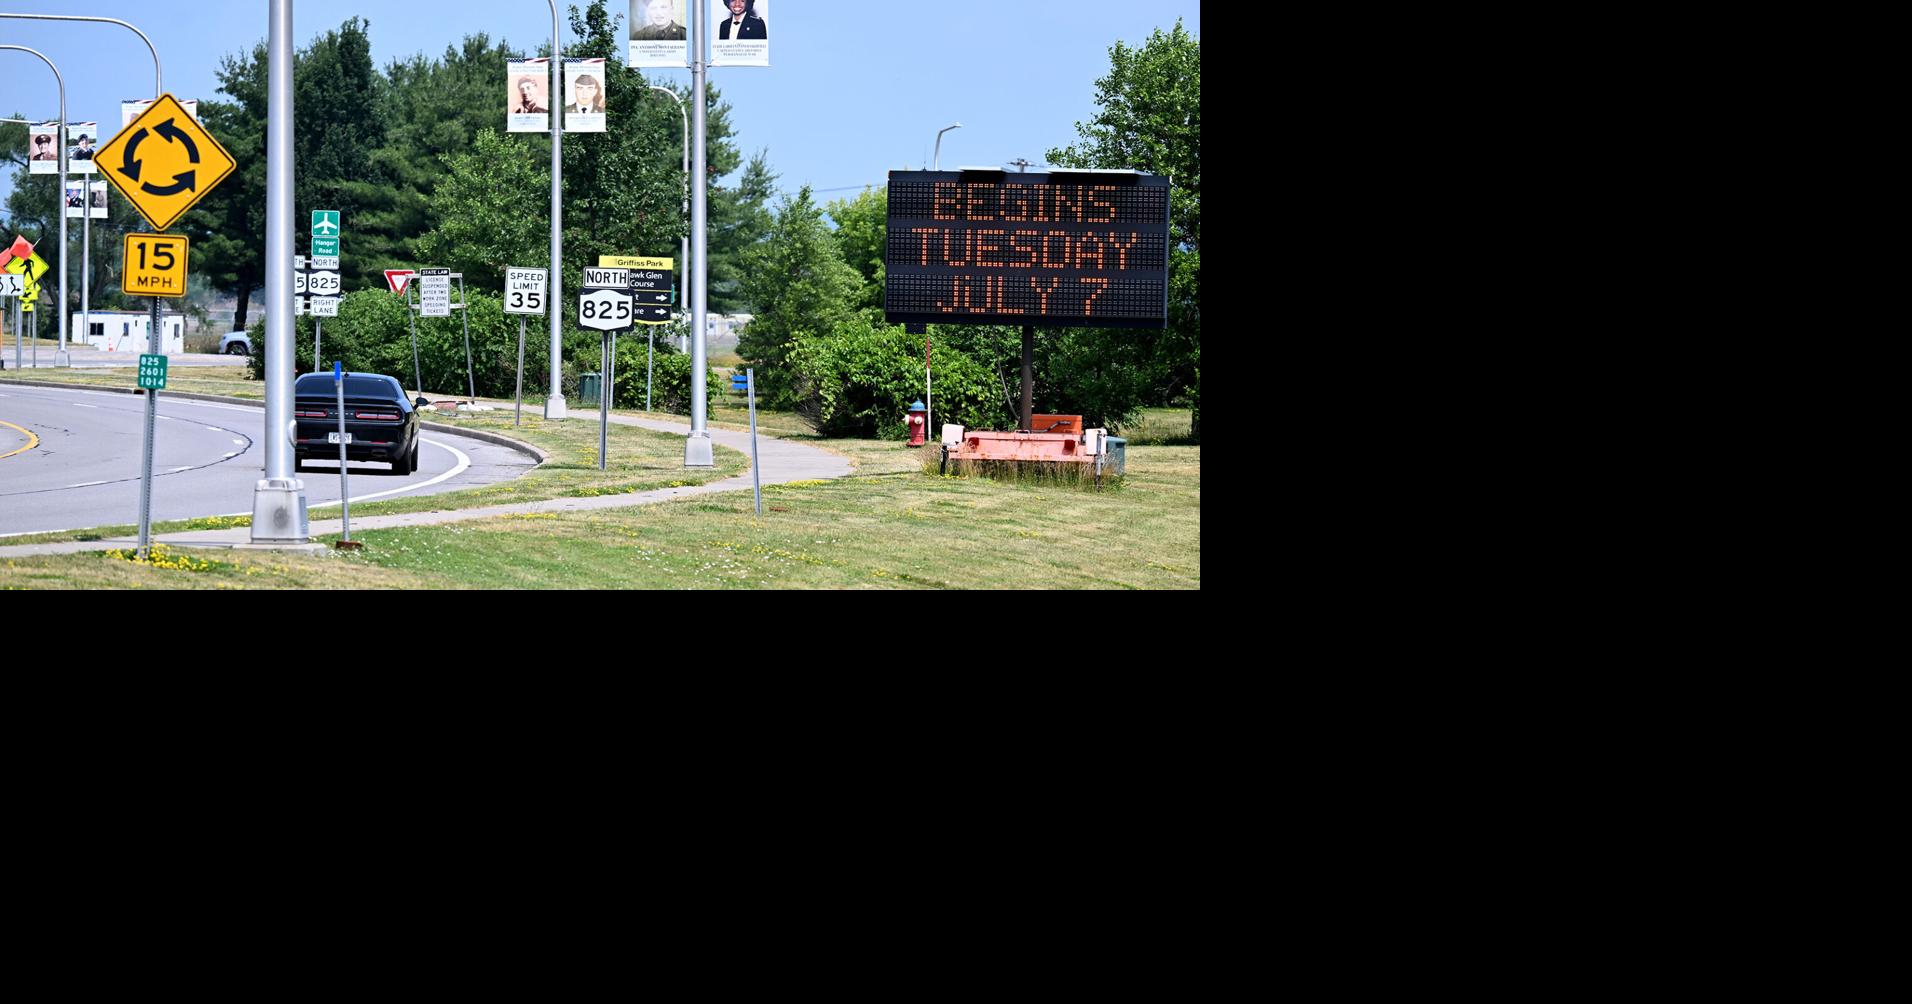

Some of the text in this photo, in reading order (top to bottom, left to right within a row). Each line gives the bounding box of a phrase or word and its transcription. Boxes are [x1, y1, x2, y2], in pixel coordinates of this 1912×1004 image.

[933, 182, 1117, 223] BEGINS
[911, 228, 1137, 270] TUESDAY
[137, 242, 175, 270] 15
[313, 258, 338, 266] NORTH
[617, 259, 645, 267] Griffiss
[510, 272, 544, 281] SPEED
[586, 270, 627, 284] NORTH
[645, 271, 663, 280] Glen
[137, 276, 172, 288] MPH
[310, 277, 339, 289] 825
[513, 282, 539, 290] LIMIT
[630, 279, 655, 288] Course
[510, 292, 540, 309] 35
[936, 275, 1108, 316] JULY 7
[582, 300, 630, 320] 825
[140, 357, 160, 366] 825
[140, 367, 164, 376] 2601
[140, 377, 164, 386] 1014
